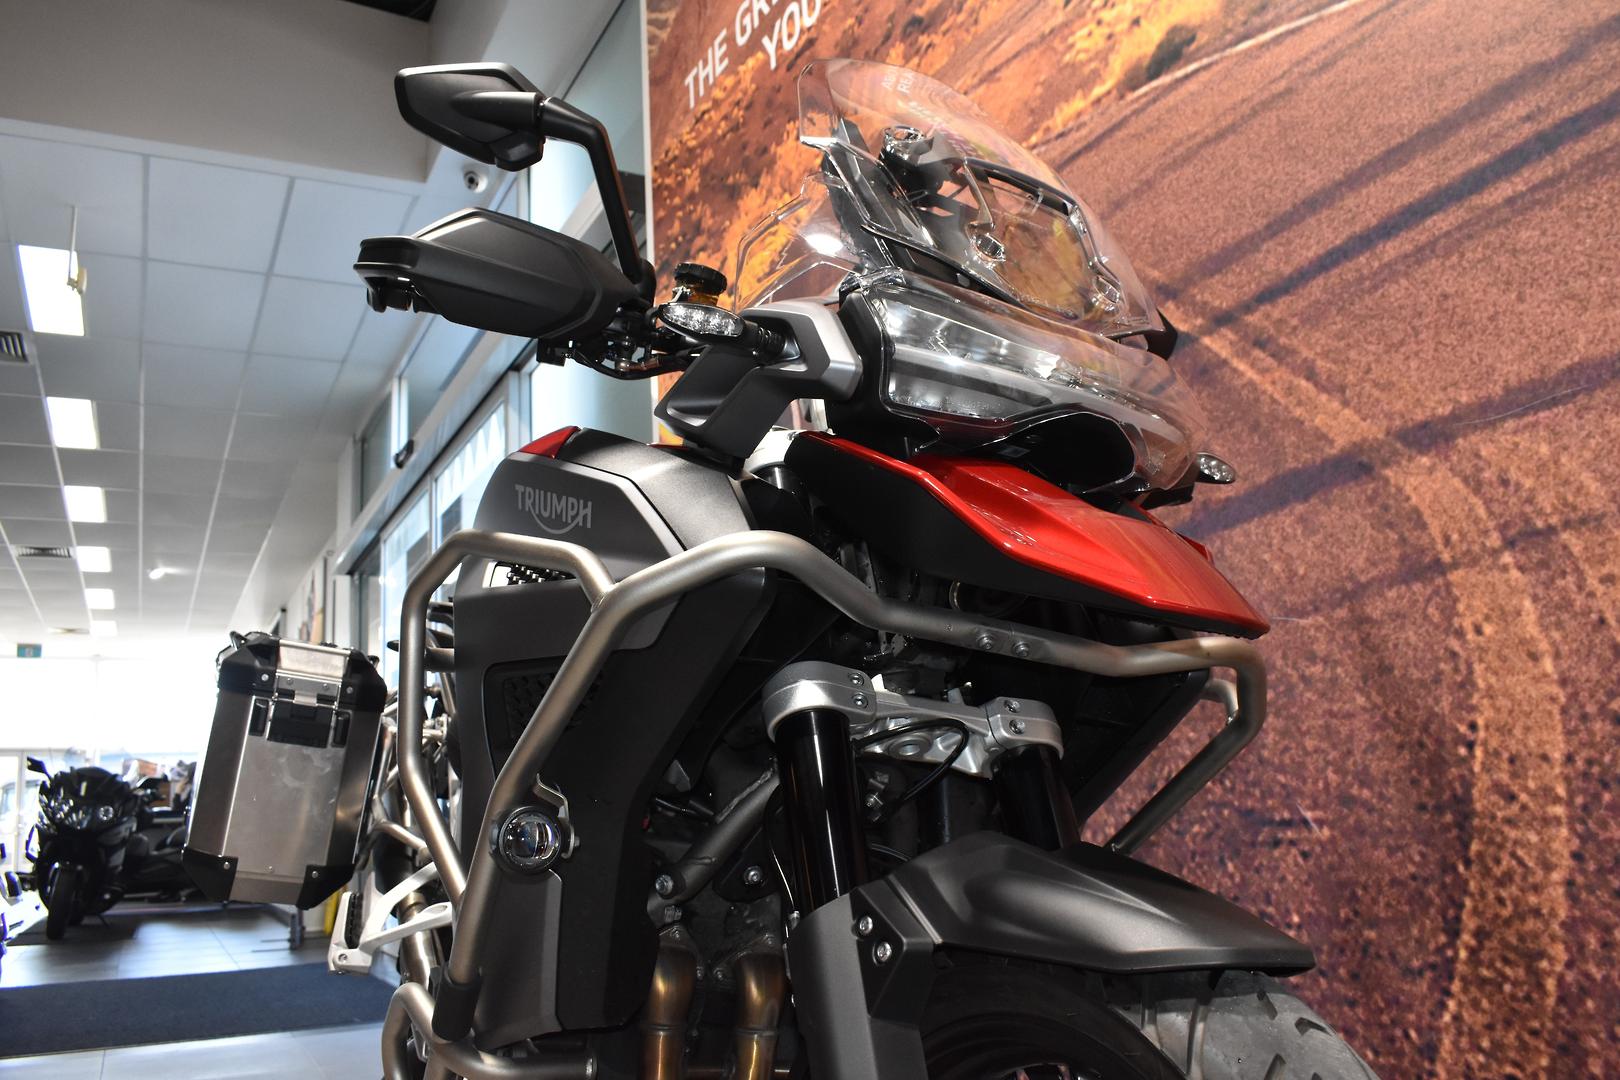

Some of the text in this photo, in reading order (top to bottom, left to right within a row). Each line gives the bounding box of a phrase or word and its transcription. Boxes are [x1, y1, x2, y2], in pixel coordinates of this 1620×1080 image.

[684, 0, 779, 109] THE GR
[761, 0, 822, 70] YOU
[515, 483, 593, 534] TRIUMPH
